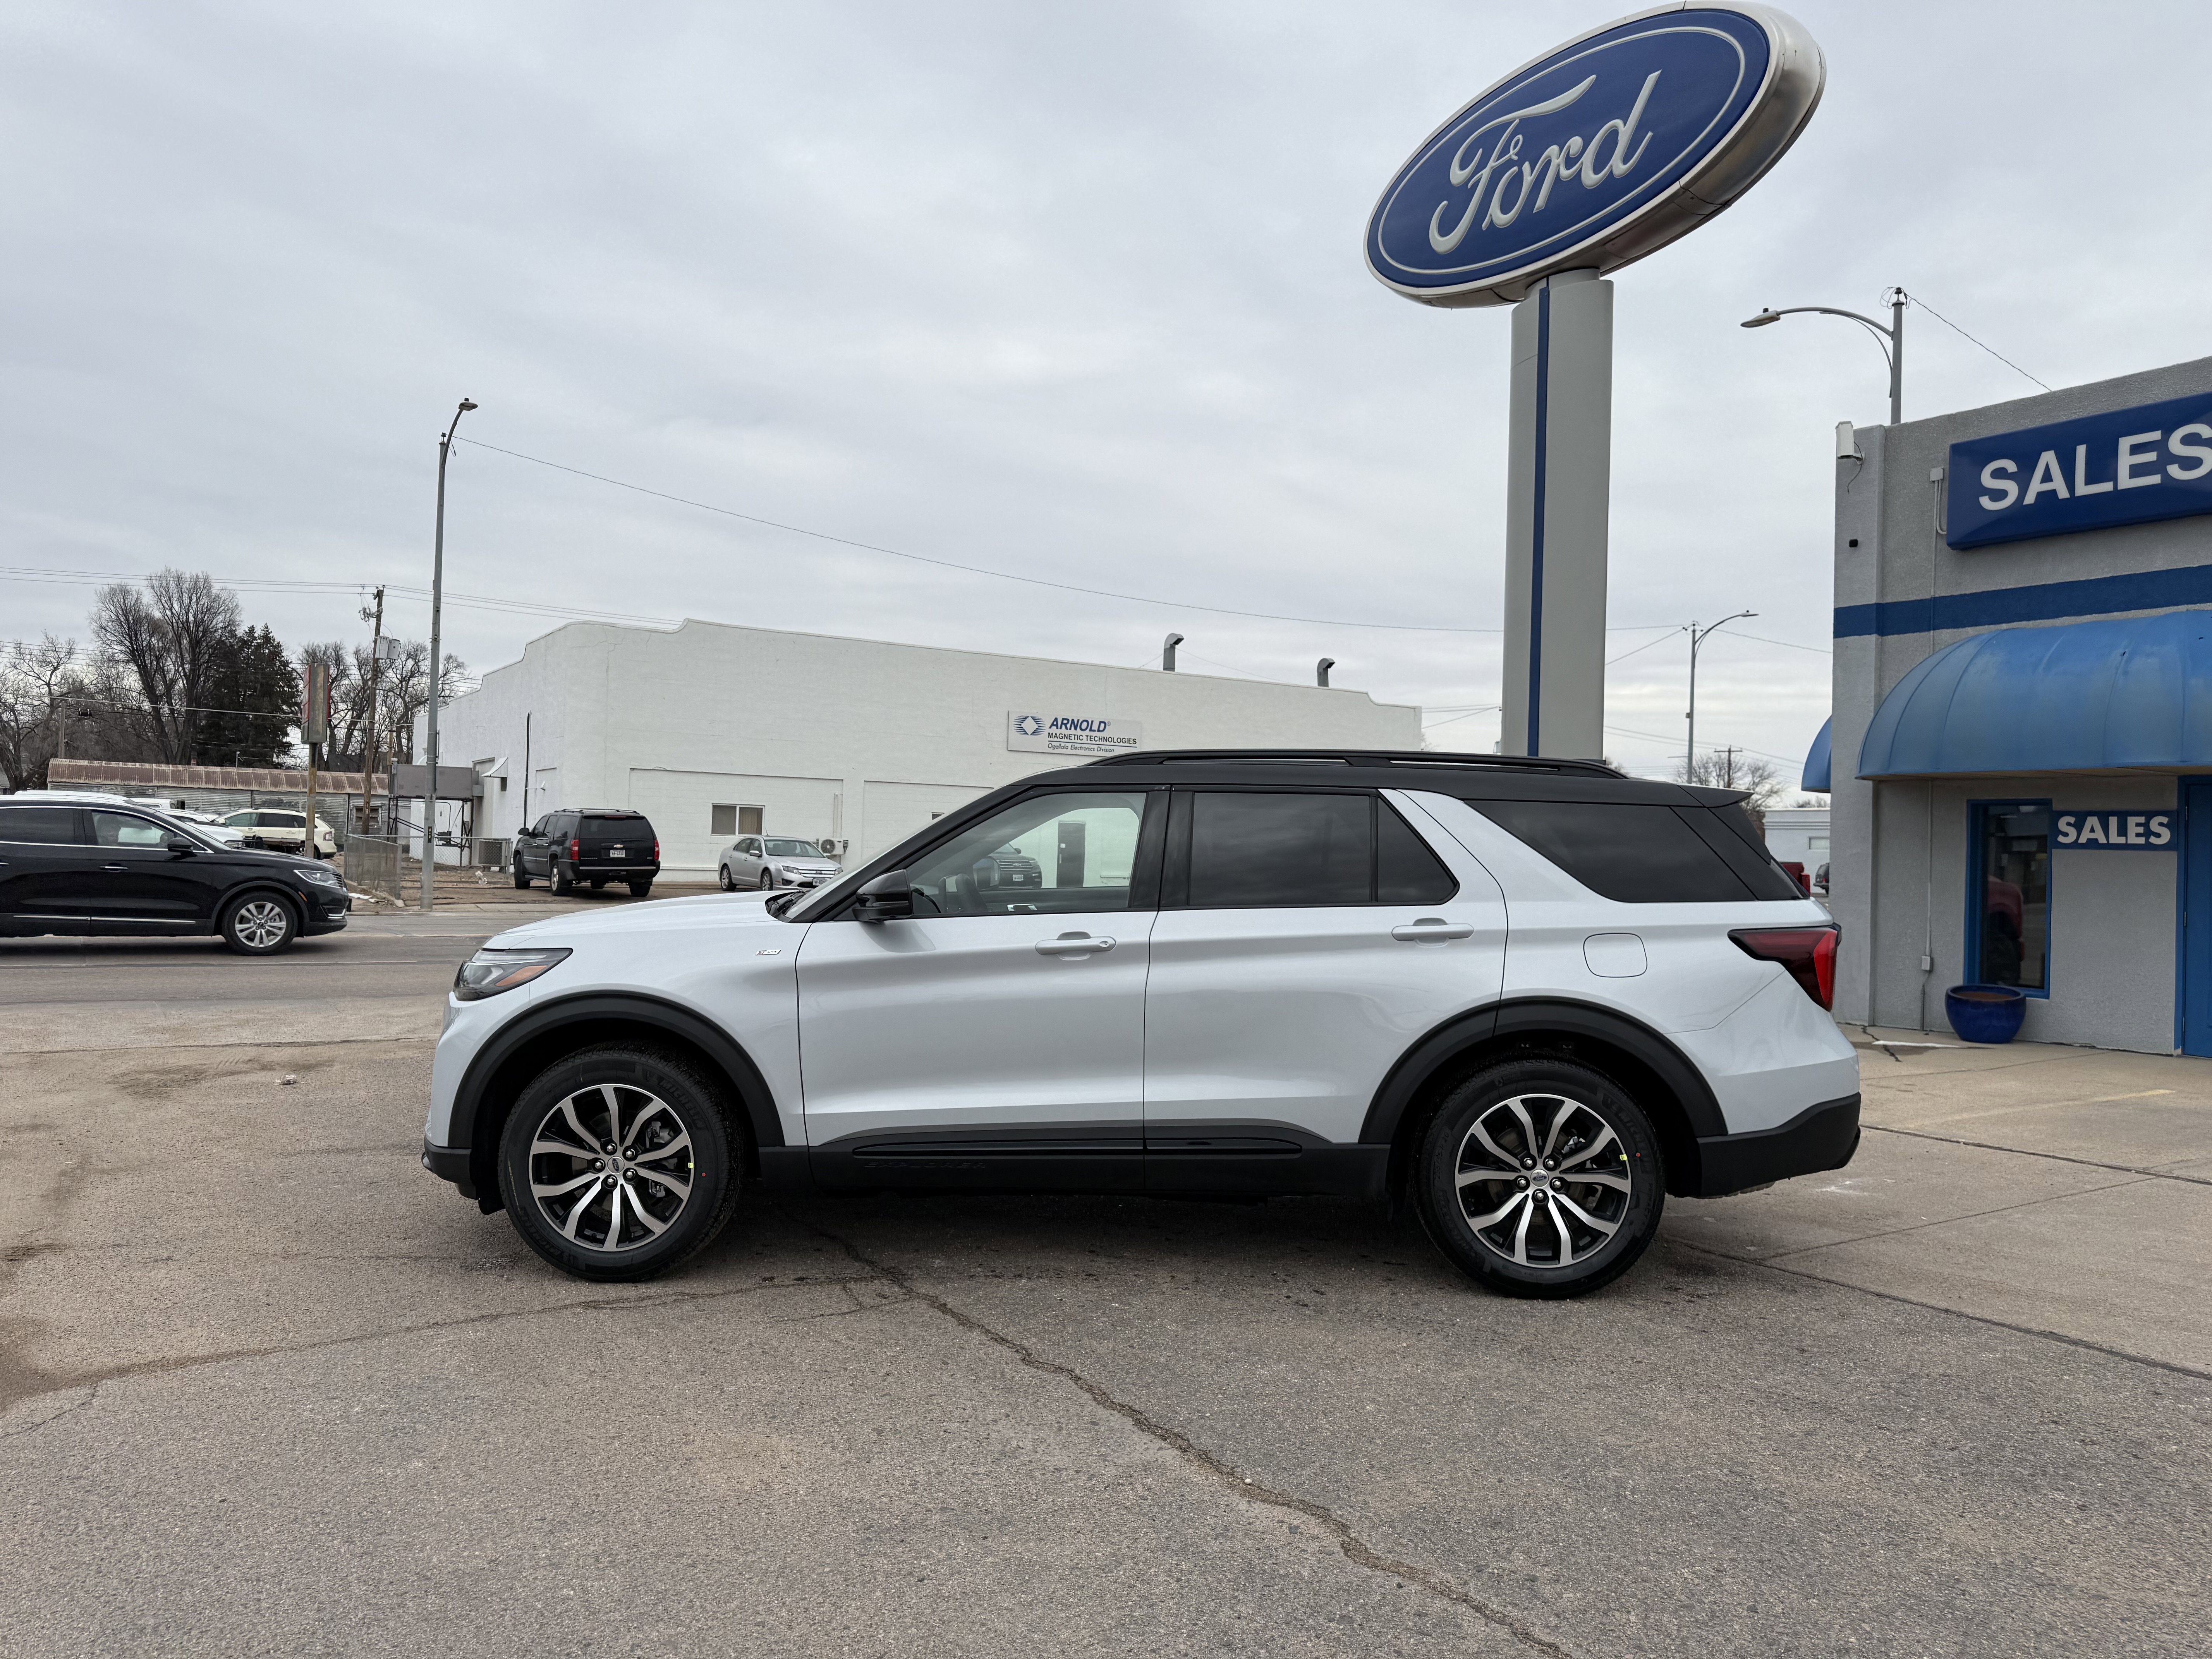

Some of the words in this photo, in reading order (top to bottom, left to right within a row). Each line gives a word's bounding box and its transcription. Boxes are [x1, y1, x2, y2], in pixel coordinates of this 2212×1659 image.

[1429, 70, 1662, 254] Ford
[1978, 423, 2212, 510] SALES
[1048, 732, 1083, 740] MAGNETIC
[1085, 735, 1137, 744] TECHNOLOGIES
[2057, 816, 2171, 845] SALES
